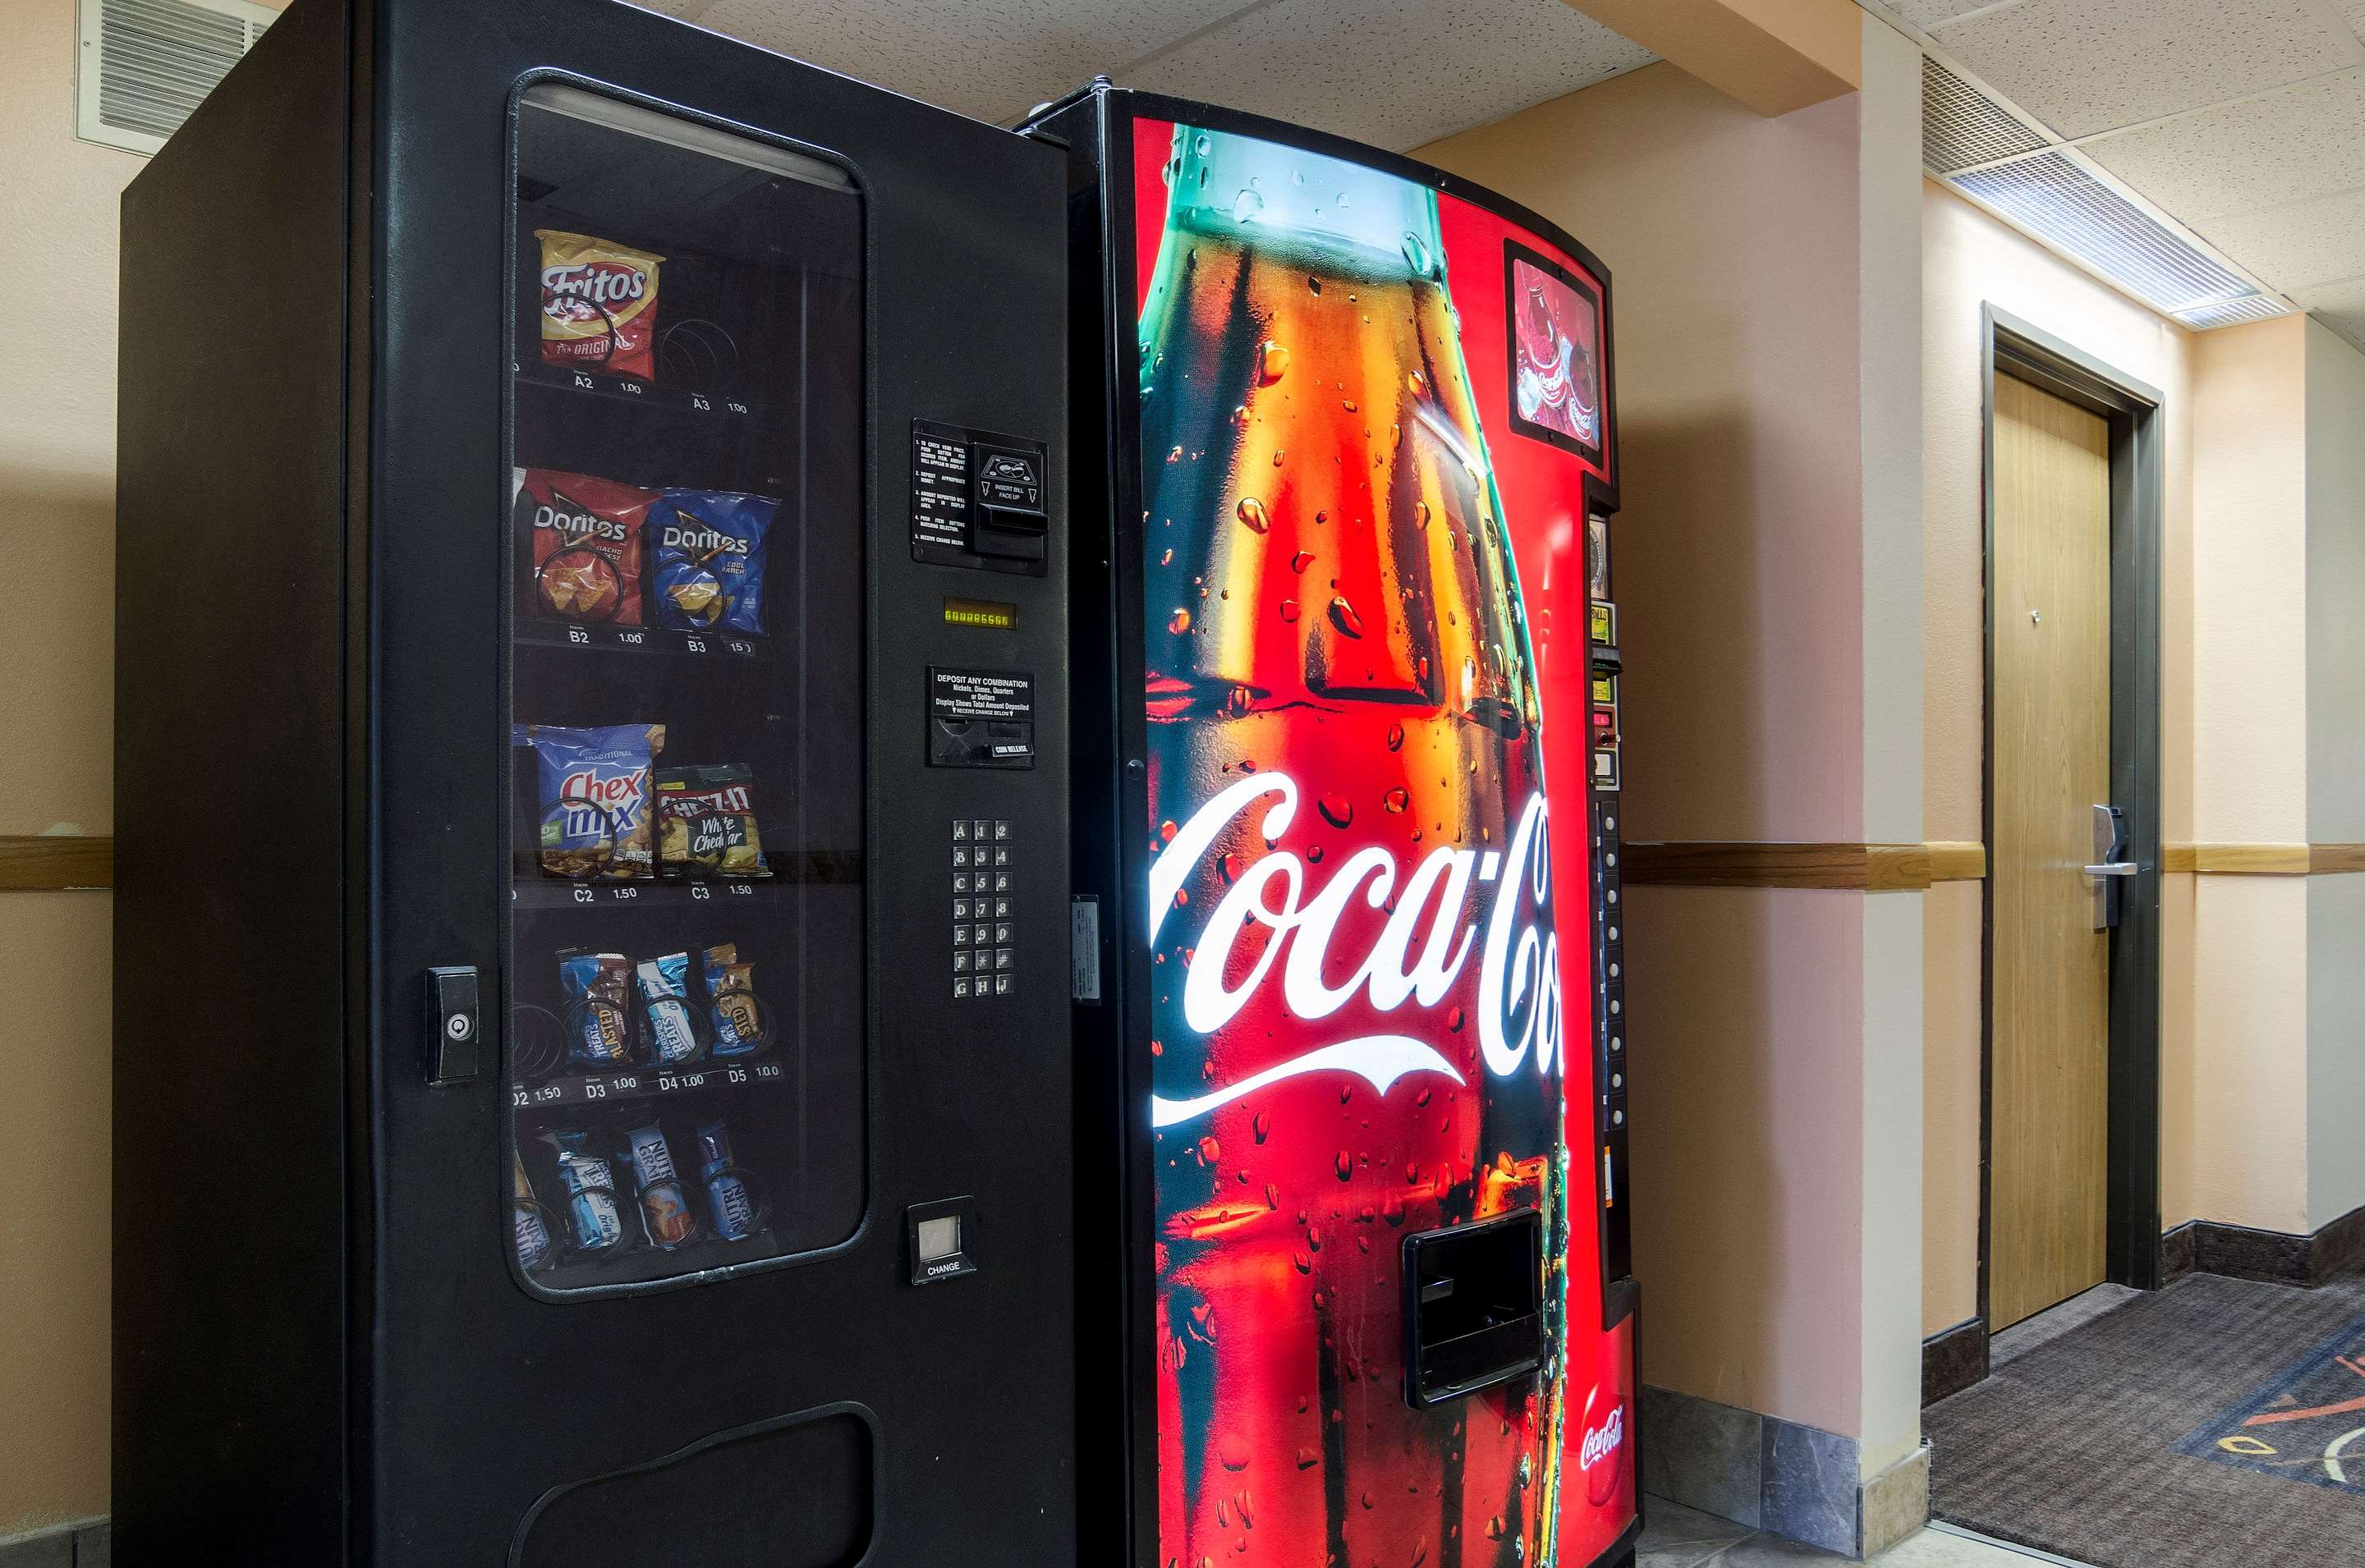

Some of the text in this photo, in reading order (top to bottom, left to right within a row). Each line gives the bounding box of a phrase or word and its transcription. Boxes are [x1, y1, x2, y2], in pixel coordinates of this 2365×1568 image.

[541, 263, 646, 314] Fritos
[575, 375, 641, 394] A2 1.00
[694, 398, 747, 414] A3 1.00
[994, 484, 1013, 492] INSERT
[534, 506, 627, 541] Doritos
[664, 527, 749, 554] Doritos
[569, 630, 642, 644] B2 1.00
[688, 640, 706, 653] B3
[937, 674, 1028, 688] DEPOSIT ANY COMBINATION
[974, 685, 992, 694] Dimes,
[993, 687, 1014, 695] Quarters
[935, 698, 955, 707] Display
[1005, 703, 1030, 711] Deposited
[562, 770, 645, 808] Chex
[957, 827, 965, 837] A
[978, 827, 984, 837] 1
[999, 826, 1006, 837] 2
[957, 852, 965, 863] B
[979, 851, 985, 862] 3
[999, 851, 1006, 861] 4
[957, 878, 966, 889] C
[979, 878, 985, 888] 5
[999, 878, 1006, 887] 6
[574, 887, 637, 902] C2 1.50
[691, 885, 752, 900] C3 1.50
[957, 904, 966, 915] D
[979, 904, 985, 915] 7
[999, 903, 1006, 913] 8
[957, 930, 966, 942] E
[979, 929, 985, 940] 9
[999, 928, 1006, 940] 0
[957, 956, 966, 968] F
[957, 983, 967, 994] G
[979, 981, 987, 992] H
[999, 979, 1006, 991] J
[590, 1024, 608, 1057] TREATS
[728, 1070, 747, 1083] D5
[586, 1077, 636, 1098] D3 1.00
[659, 1075, 705, 1091] D4 1.00
[534, 1086, 562, 1101] 1.50
[927, 1262, 961, 1276] CHANGE
